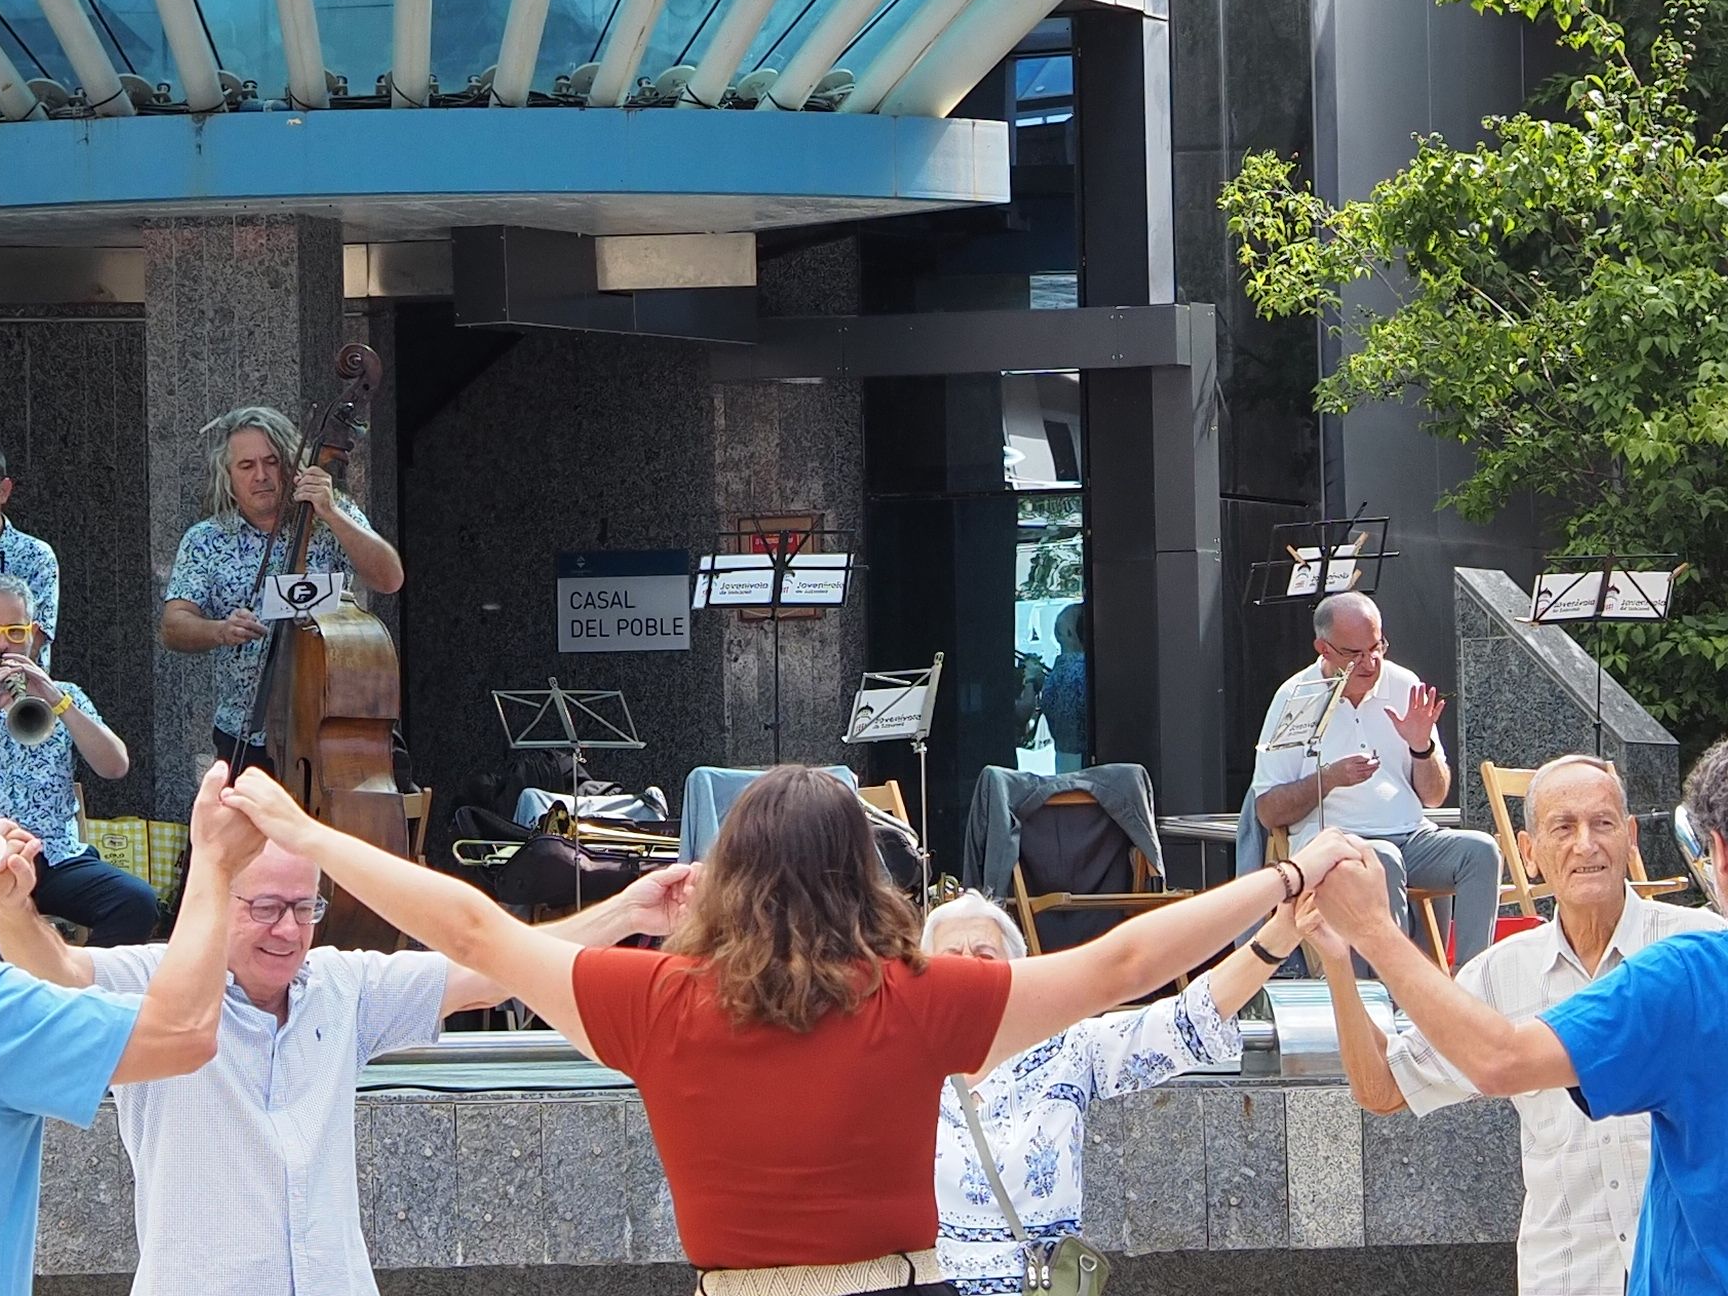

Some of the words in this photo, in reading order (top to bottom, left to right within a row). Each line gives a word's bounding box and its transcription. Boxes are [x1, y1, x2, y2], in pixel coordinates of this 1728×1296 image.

[569, 590, 637, 610] CASAL
[570, 618, 610, 638] DEL
[616, 617, 684, 637] POBLE
